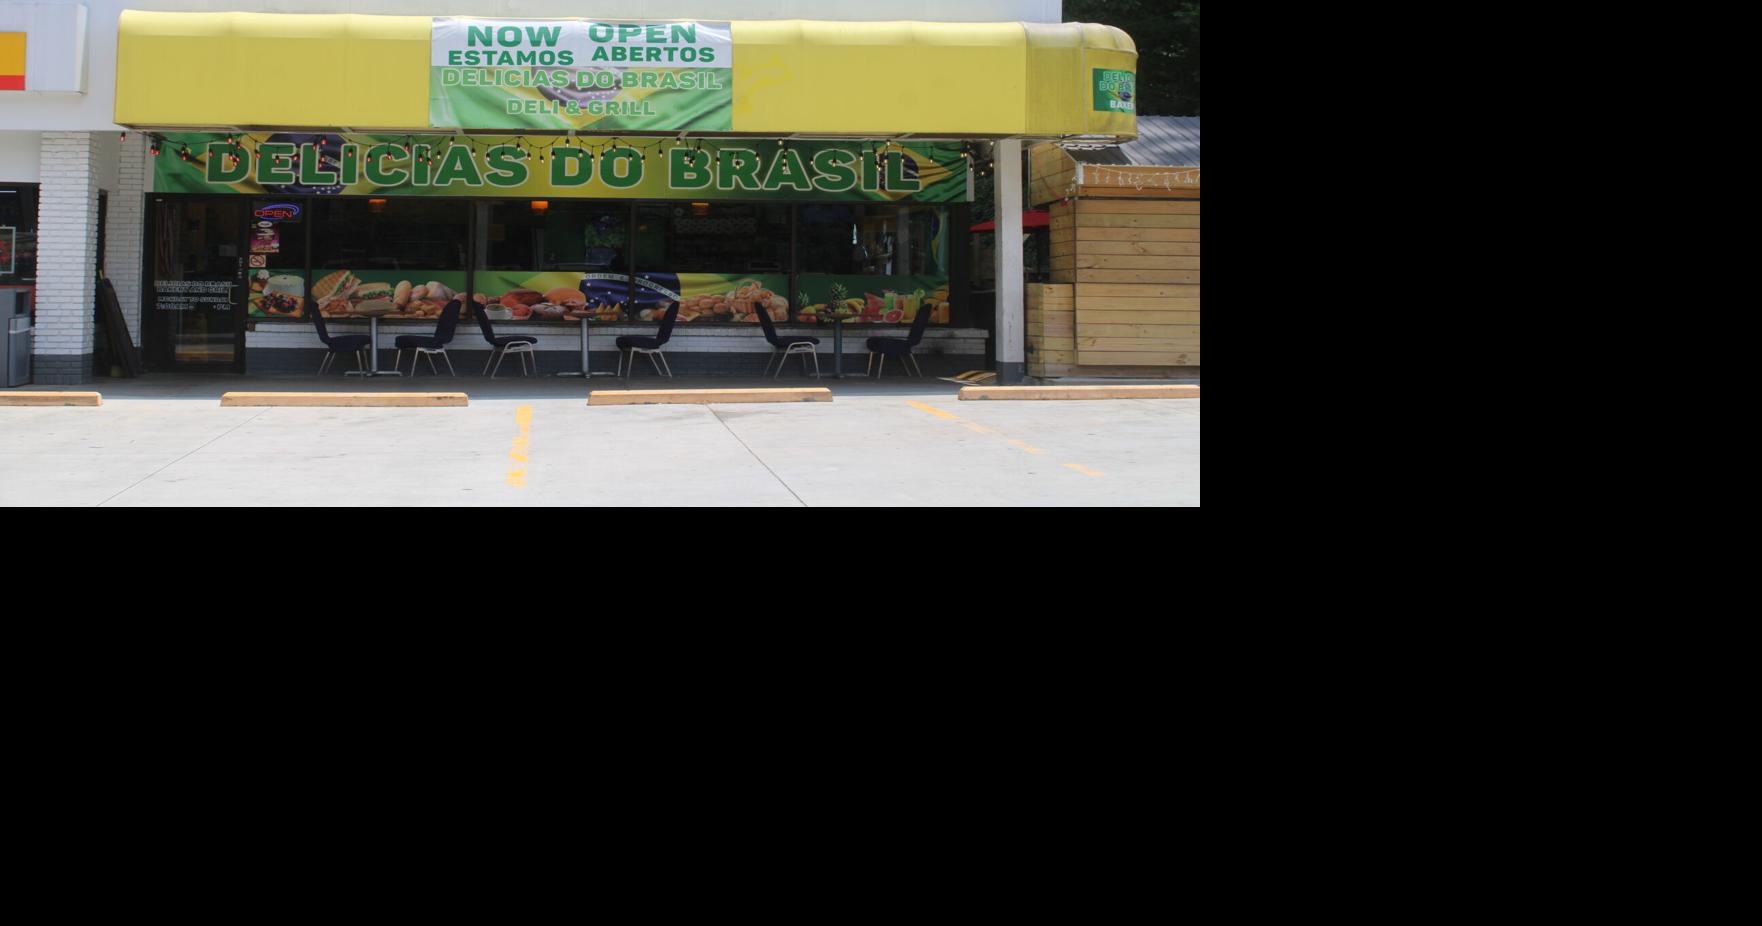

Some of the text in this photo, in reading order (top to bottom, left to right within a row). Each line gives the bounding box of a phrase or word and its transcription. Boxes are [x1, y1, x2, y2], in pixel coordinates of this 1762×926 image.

[466, 23, 696, 47] NOW OPEN
[448, 46, 715, 66] ESTAMOS ABERTOS
[441, 68, 722, 90] DELICIAS DO BRASIL
[506, 99, 656, 117] DELI & GRILL
[206, 143, 922, 191] DELICIAS DO BRASIL
[254, 209, 292, 219] OPEN
